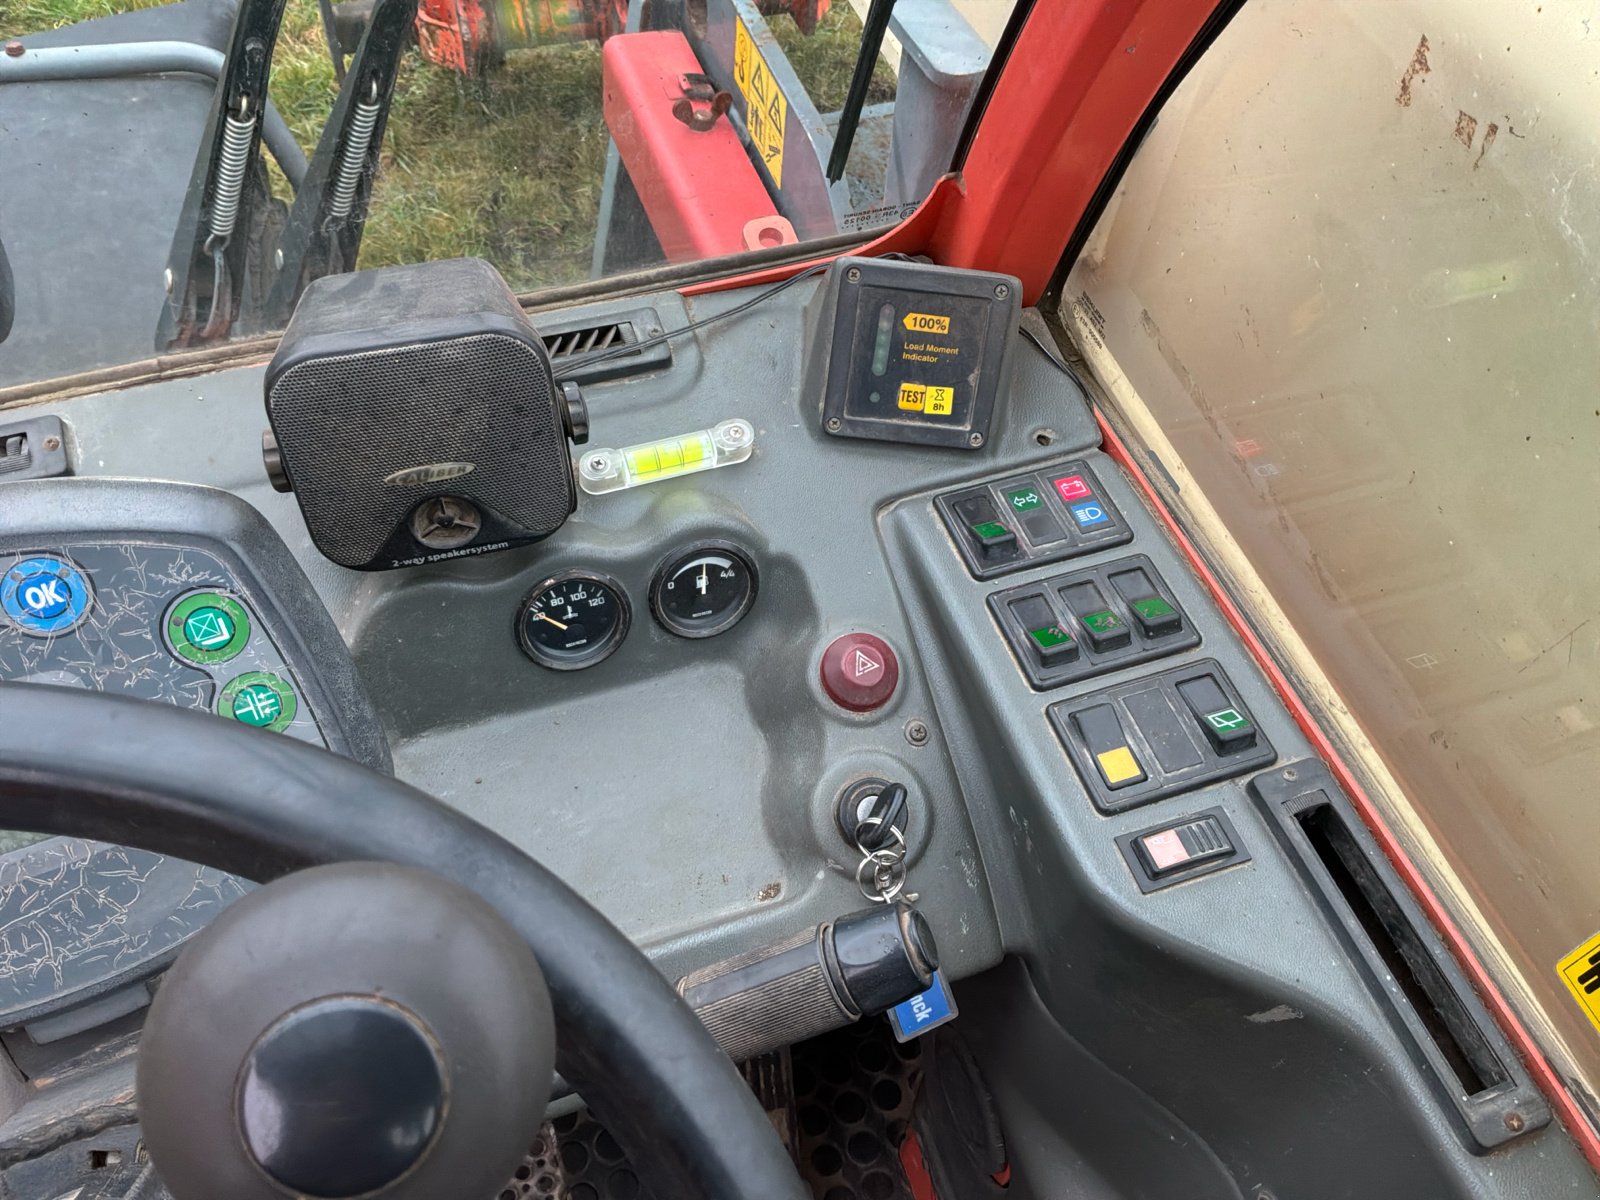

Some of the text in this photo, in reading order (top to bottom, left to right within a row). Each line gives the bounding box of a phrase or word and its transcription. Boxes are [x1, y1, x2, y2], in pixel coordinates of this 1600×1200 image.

[912, 316, 947, 331] 100%
[904, 341, 959, 355] Load Moment
[902, 352, 939, 363] Indicator
[901, 389, 925, 405] TEST
[932, 402, 945, 412] 8h
[395, 465, 468, 485] CALIBER
[391, 541, 509, 567] 2-way speakersystem
[25, 579, 66, 610] OK
[569, 591, 588, 602] 100
[550, 597, 565, 607] 80
[588, 596, 606, 608] 120
